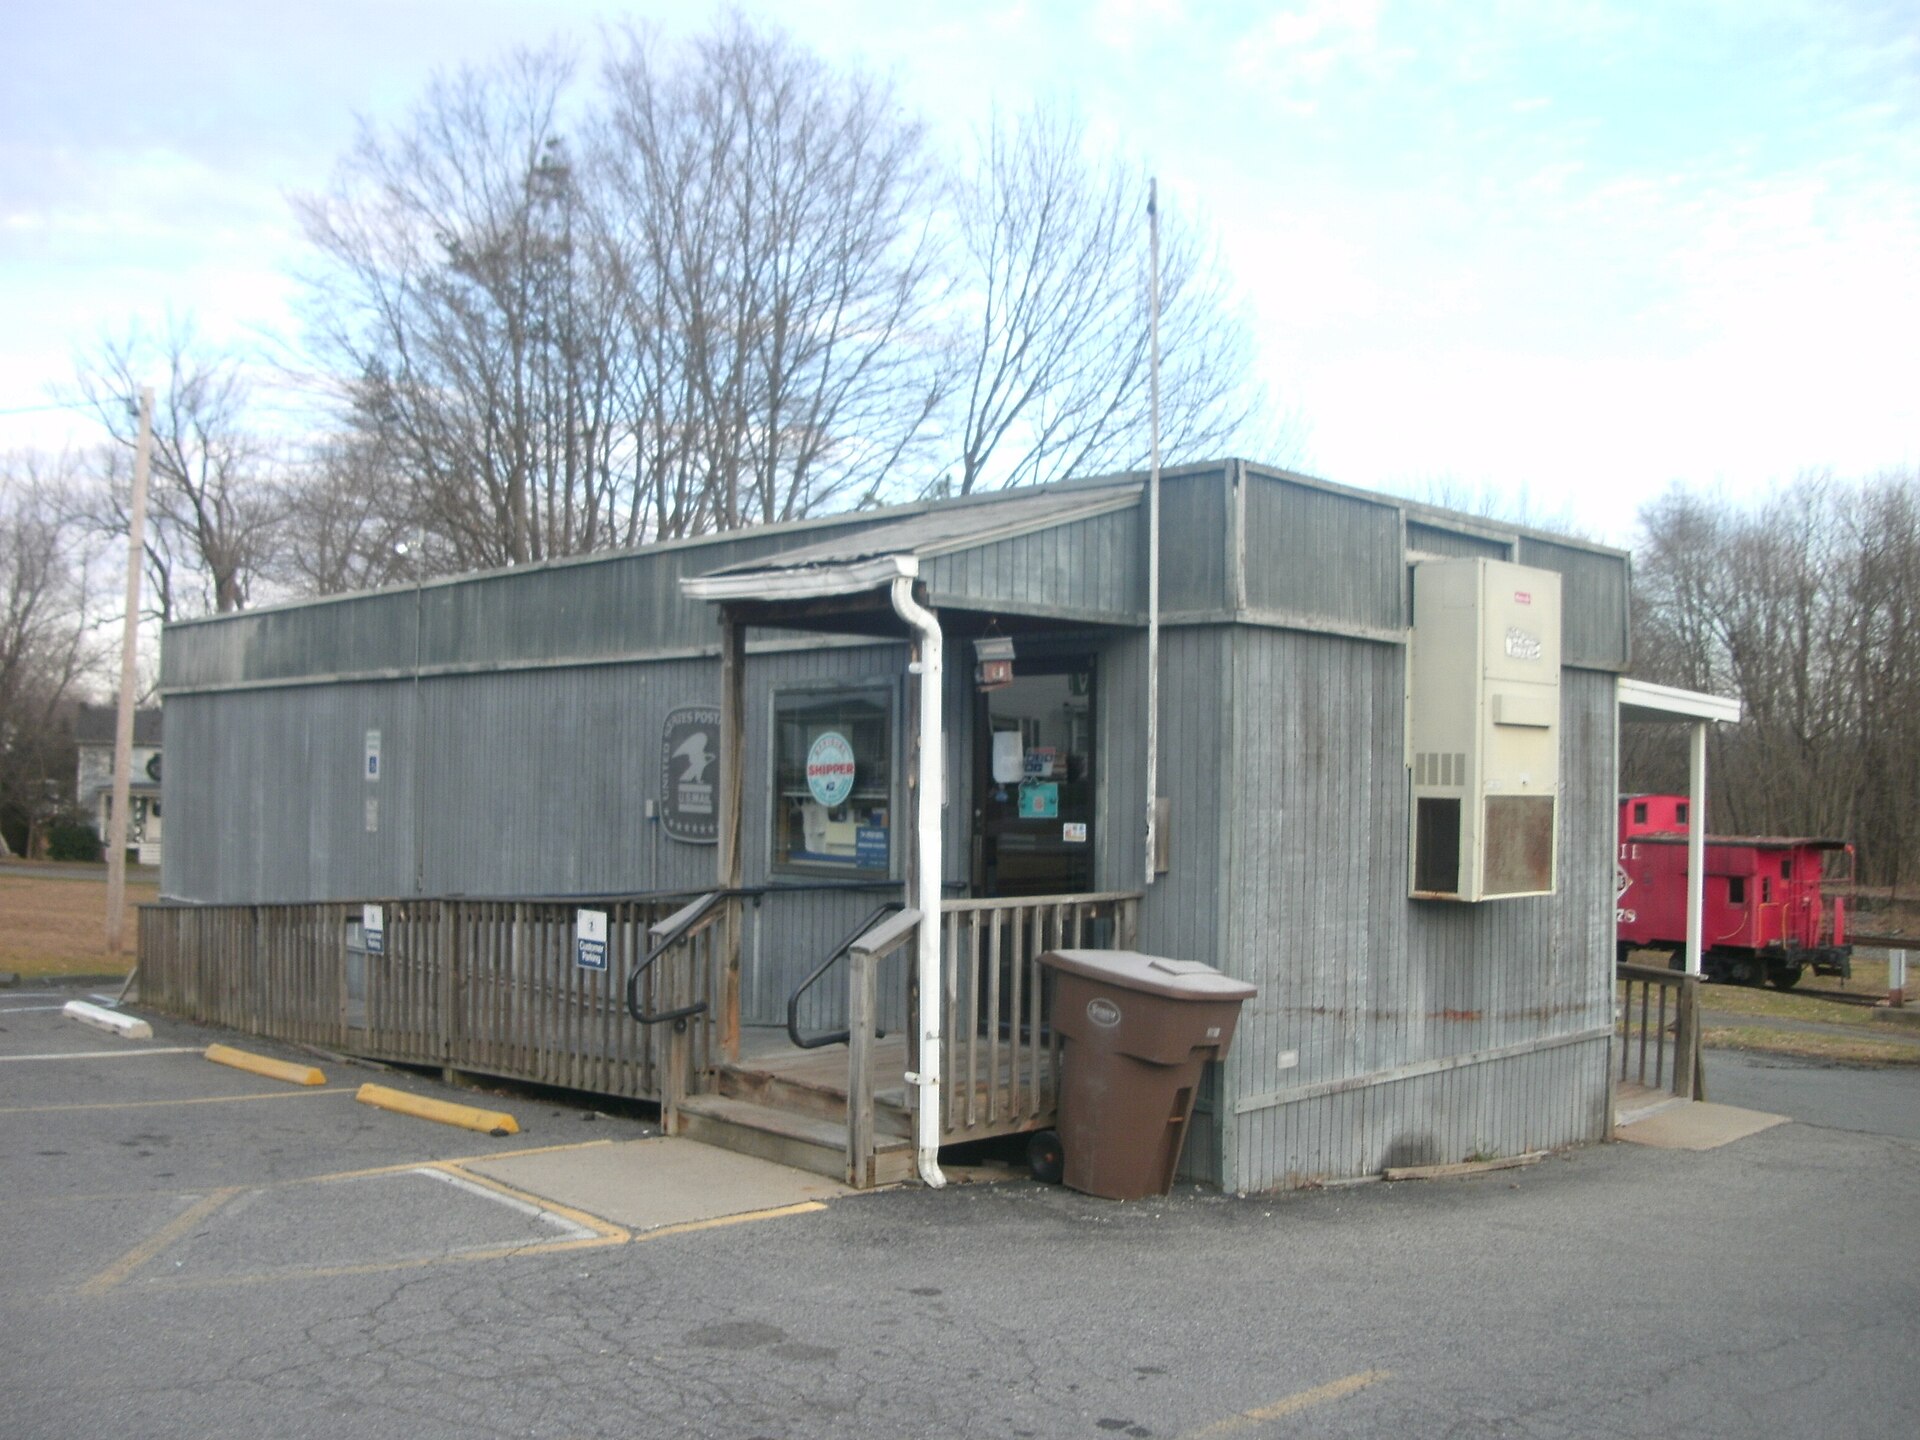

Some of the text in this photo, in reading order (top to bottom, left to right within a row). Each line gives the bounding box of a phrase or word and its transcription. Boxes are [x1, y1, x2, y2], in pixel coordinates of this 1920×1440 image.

[663, 711, 693, 738] STATES
[662, 742, 671, 801] UNITED
[808, 763, 854, 777] SHIPPER
[580, 941, 604, 954] Customer
[582, 951, 601, 965] Parking
